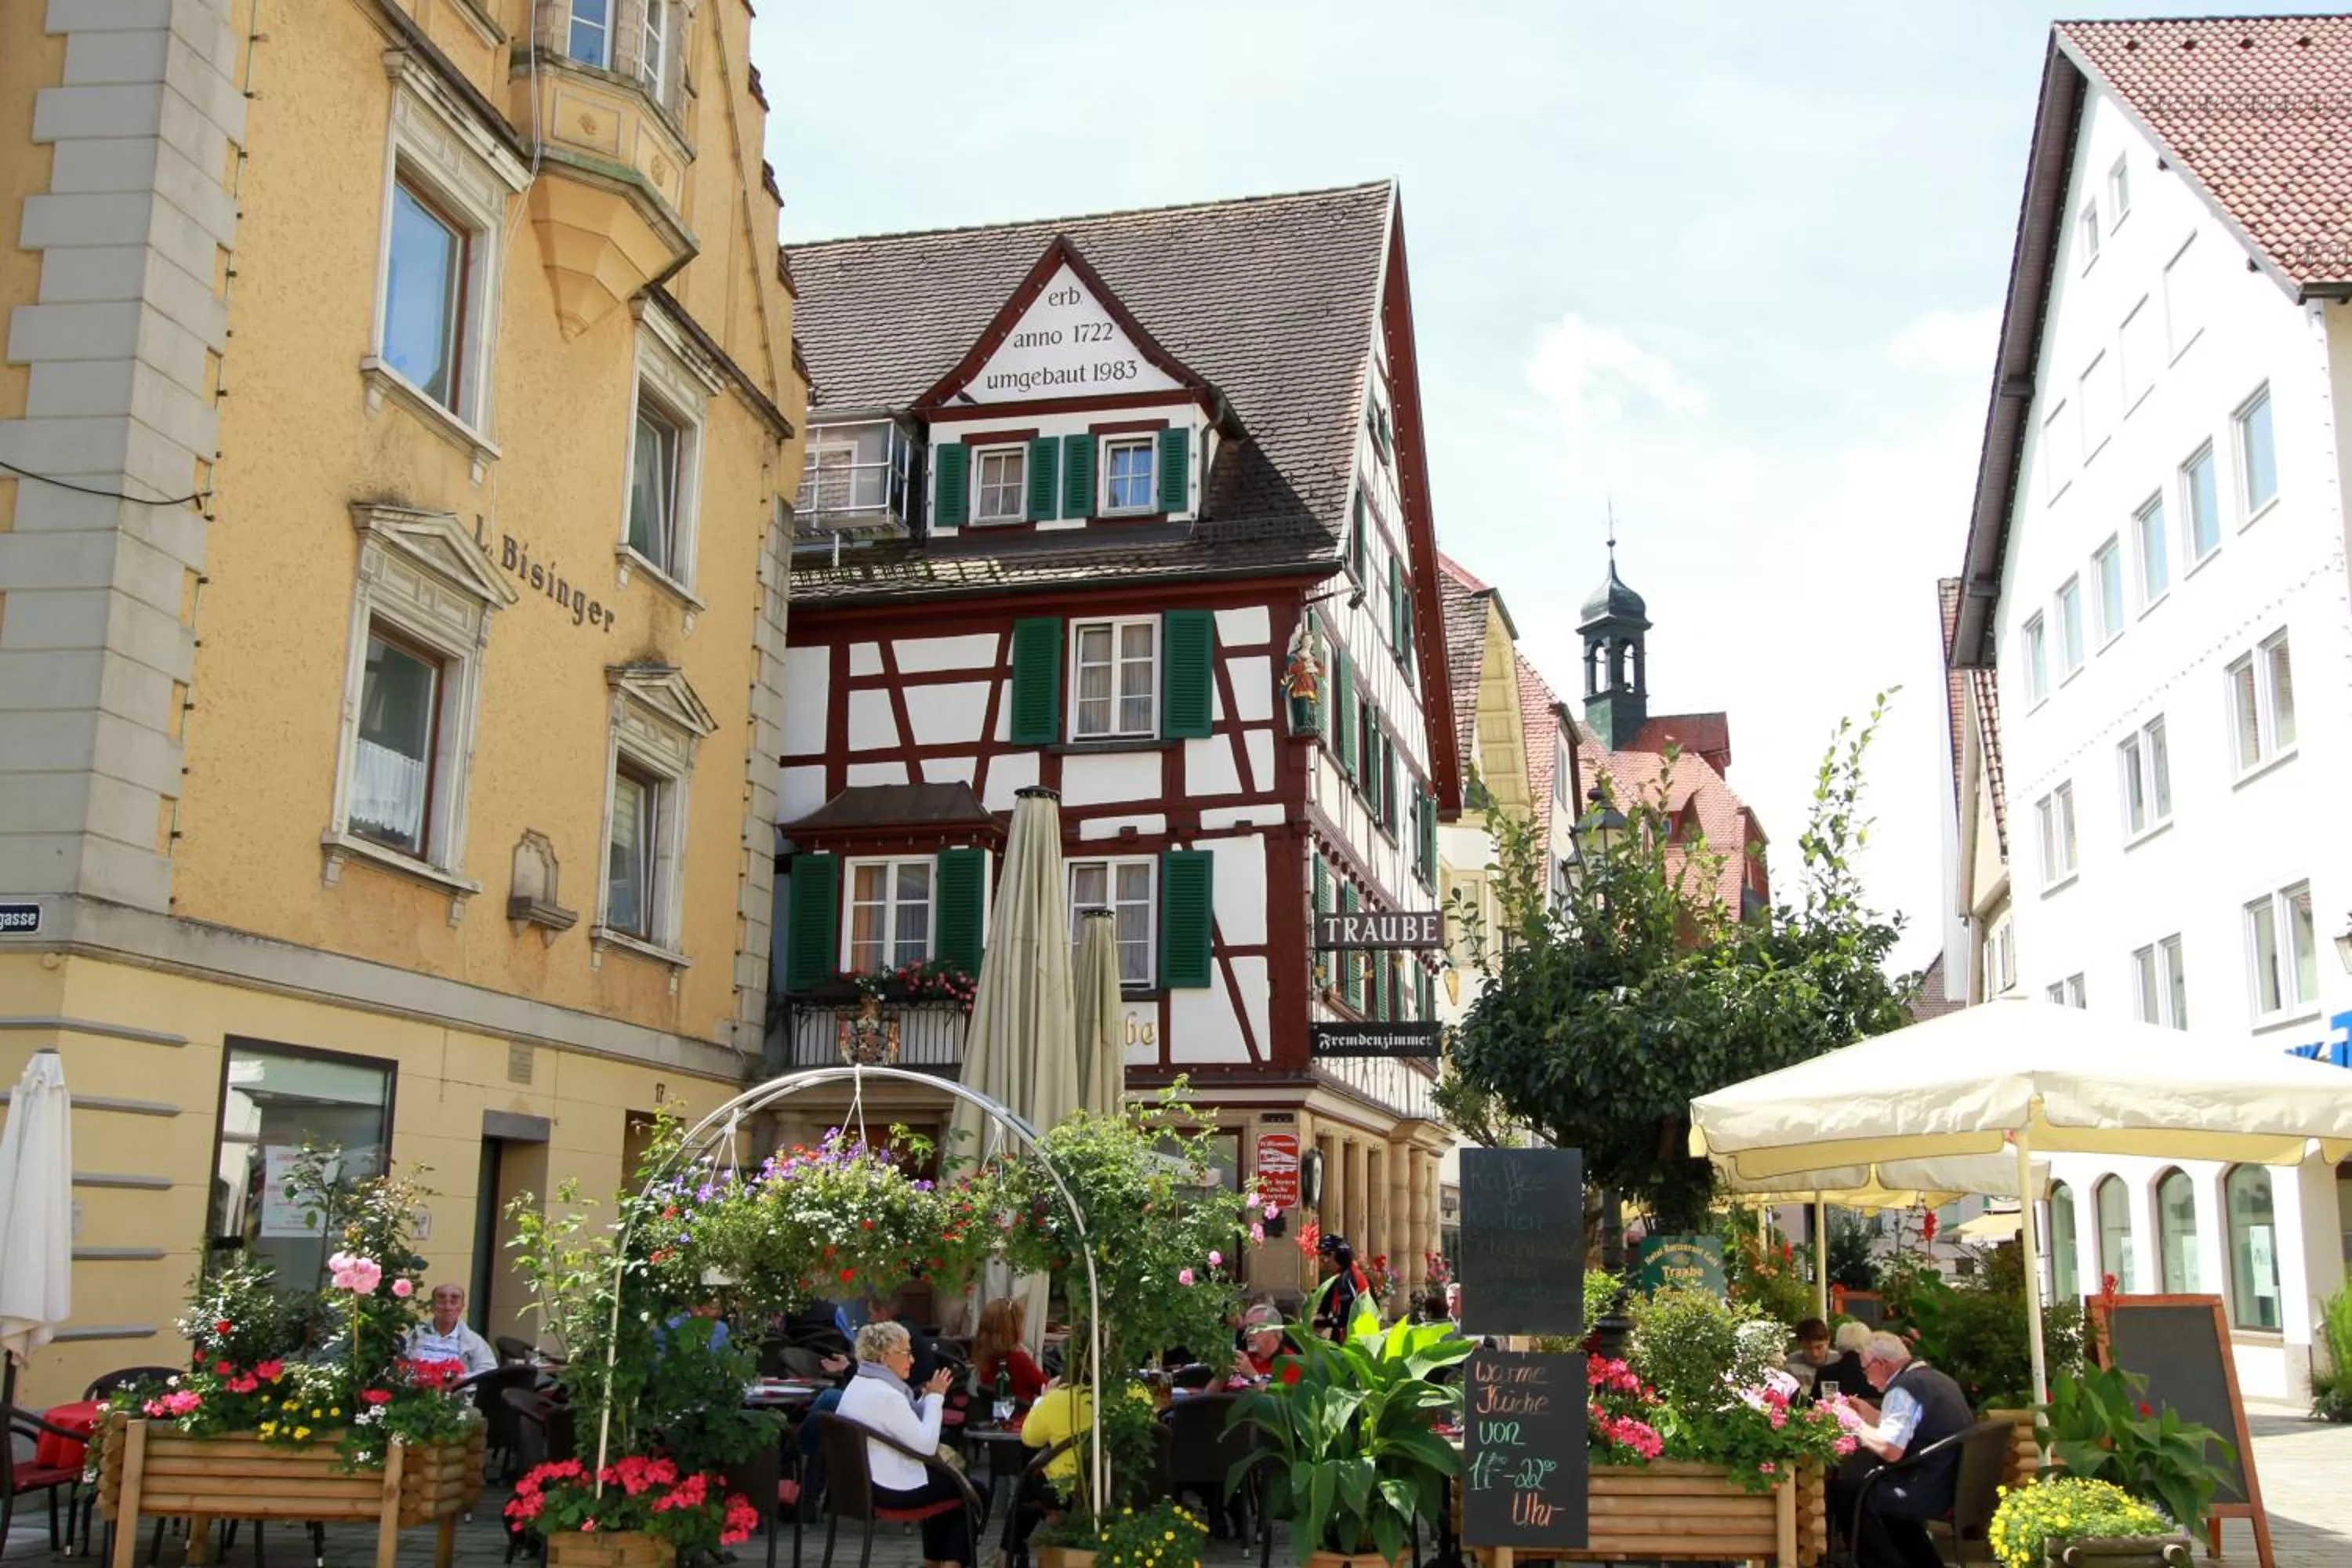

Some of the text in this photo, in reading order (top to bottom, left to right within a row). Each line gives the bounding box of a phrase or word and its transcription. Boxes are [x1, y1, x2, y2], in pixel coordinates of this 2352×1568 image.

[1013, 322, 1113, 348] anno 1722
[986, 360, 1138, 392] umgebaut 1983
[502, 534, 615, 633] Bisinger
[1323, 916, 1437, 942] TRAUBE
[1661, 1265, 1706, 1278] Traube
[1512, 1492, 1566, 1528] Uhr
